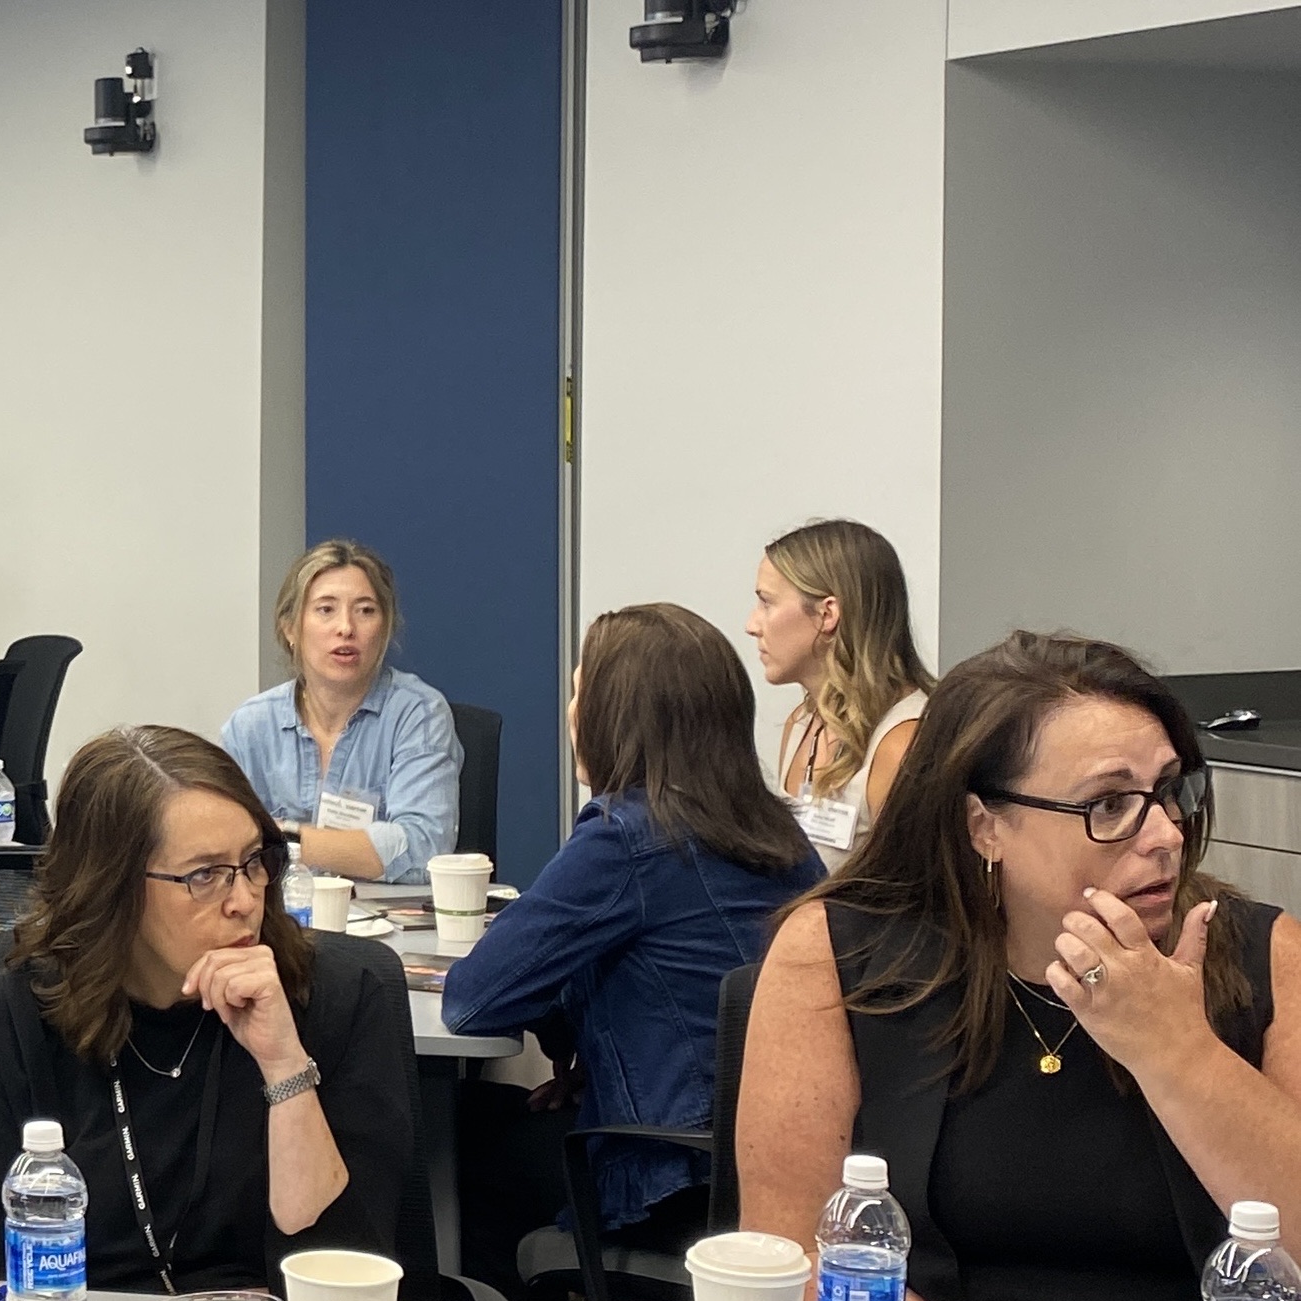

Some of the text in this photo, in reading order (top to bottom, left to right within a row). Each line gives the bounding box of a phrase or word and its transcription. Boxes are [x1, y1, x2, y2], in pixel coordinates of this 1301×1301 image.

[113, 1079, 126, 1114] GARMIN
[122, 1125, 136, 1161] GARMIN
[131, 1172, 147, 1211] GARMIN
[144, 1223, 160, 1258] GARMIN
